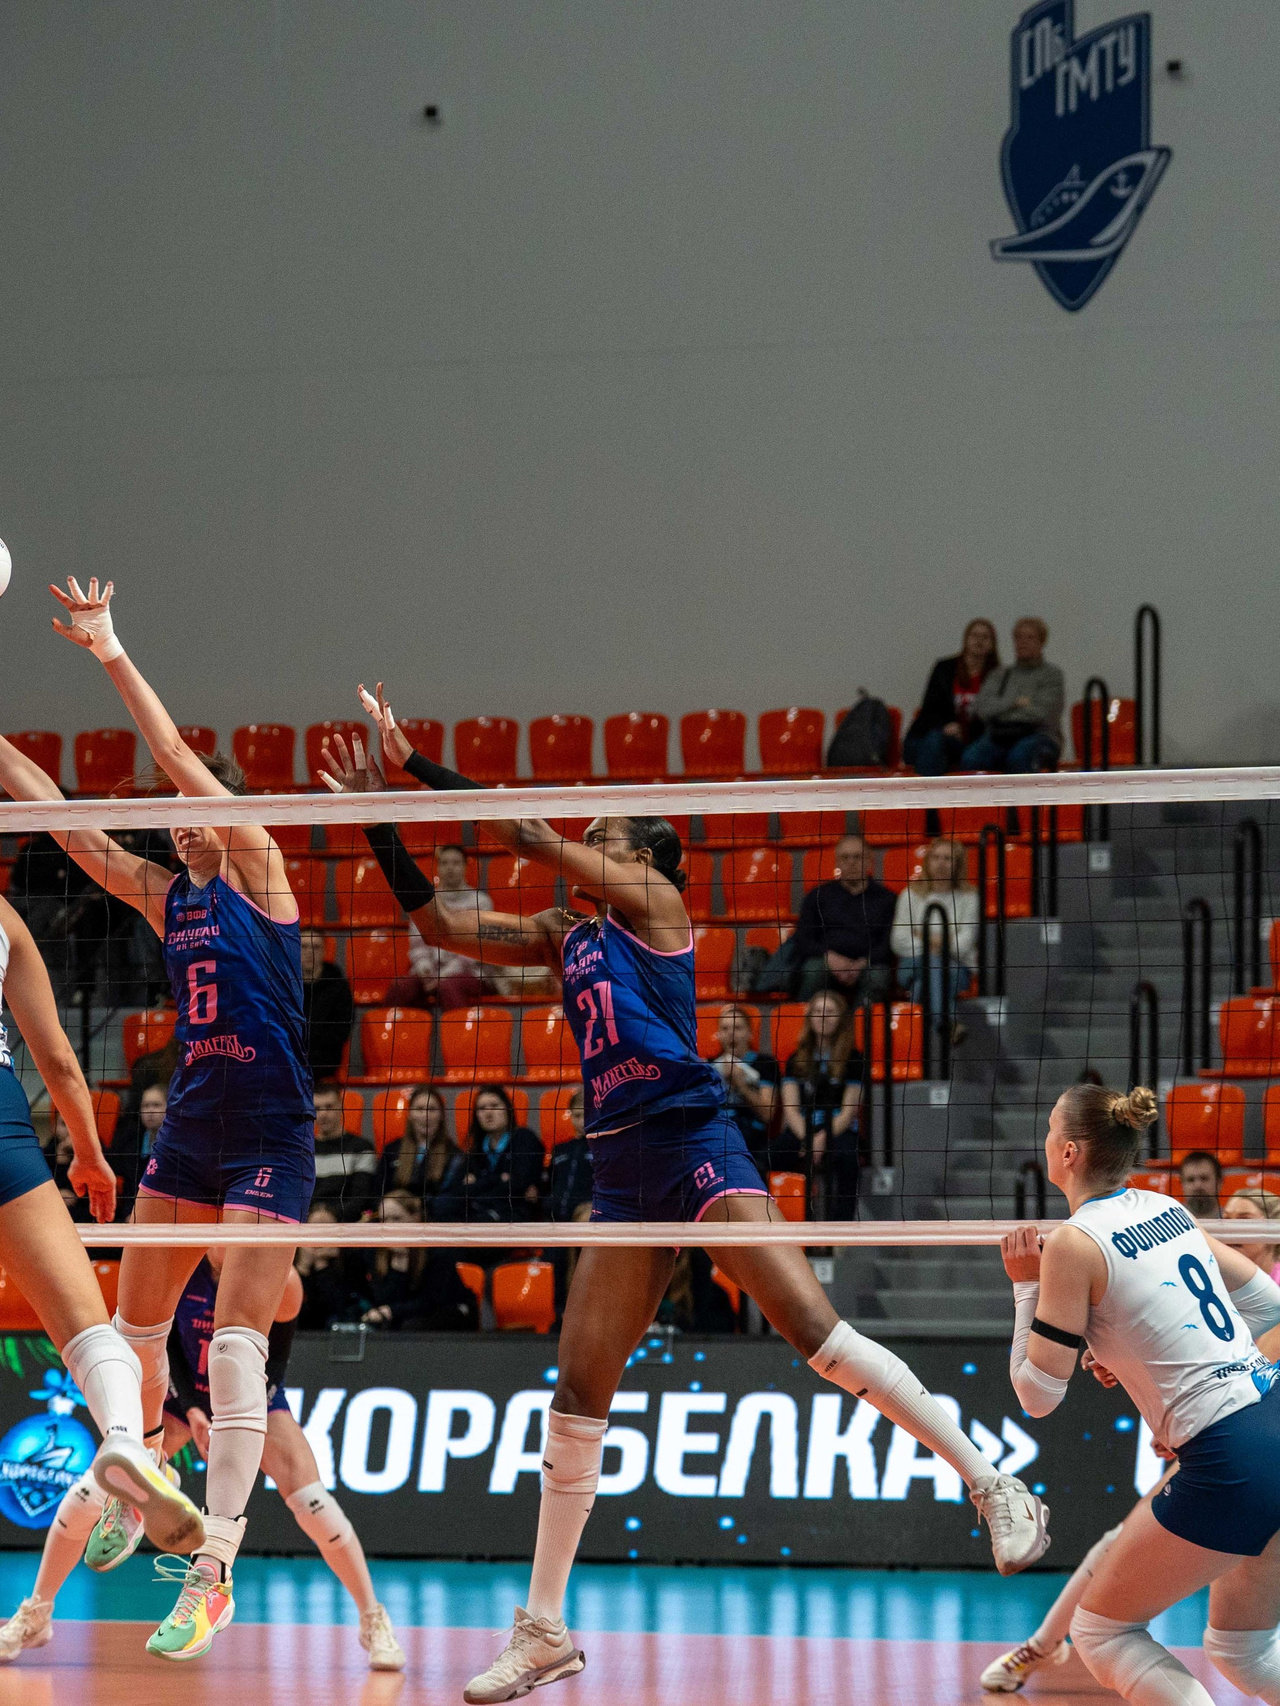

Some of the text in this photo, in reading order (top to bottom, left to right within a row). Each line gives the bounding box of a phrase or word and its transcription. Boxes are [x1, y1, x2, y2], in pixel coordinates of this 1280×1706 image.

[186, 959, 219, 1026] 6
[576, 980, 621, 1060] 21
[1177, 1253, 1235, 1343] 8
